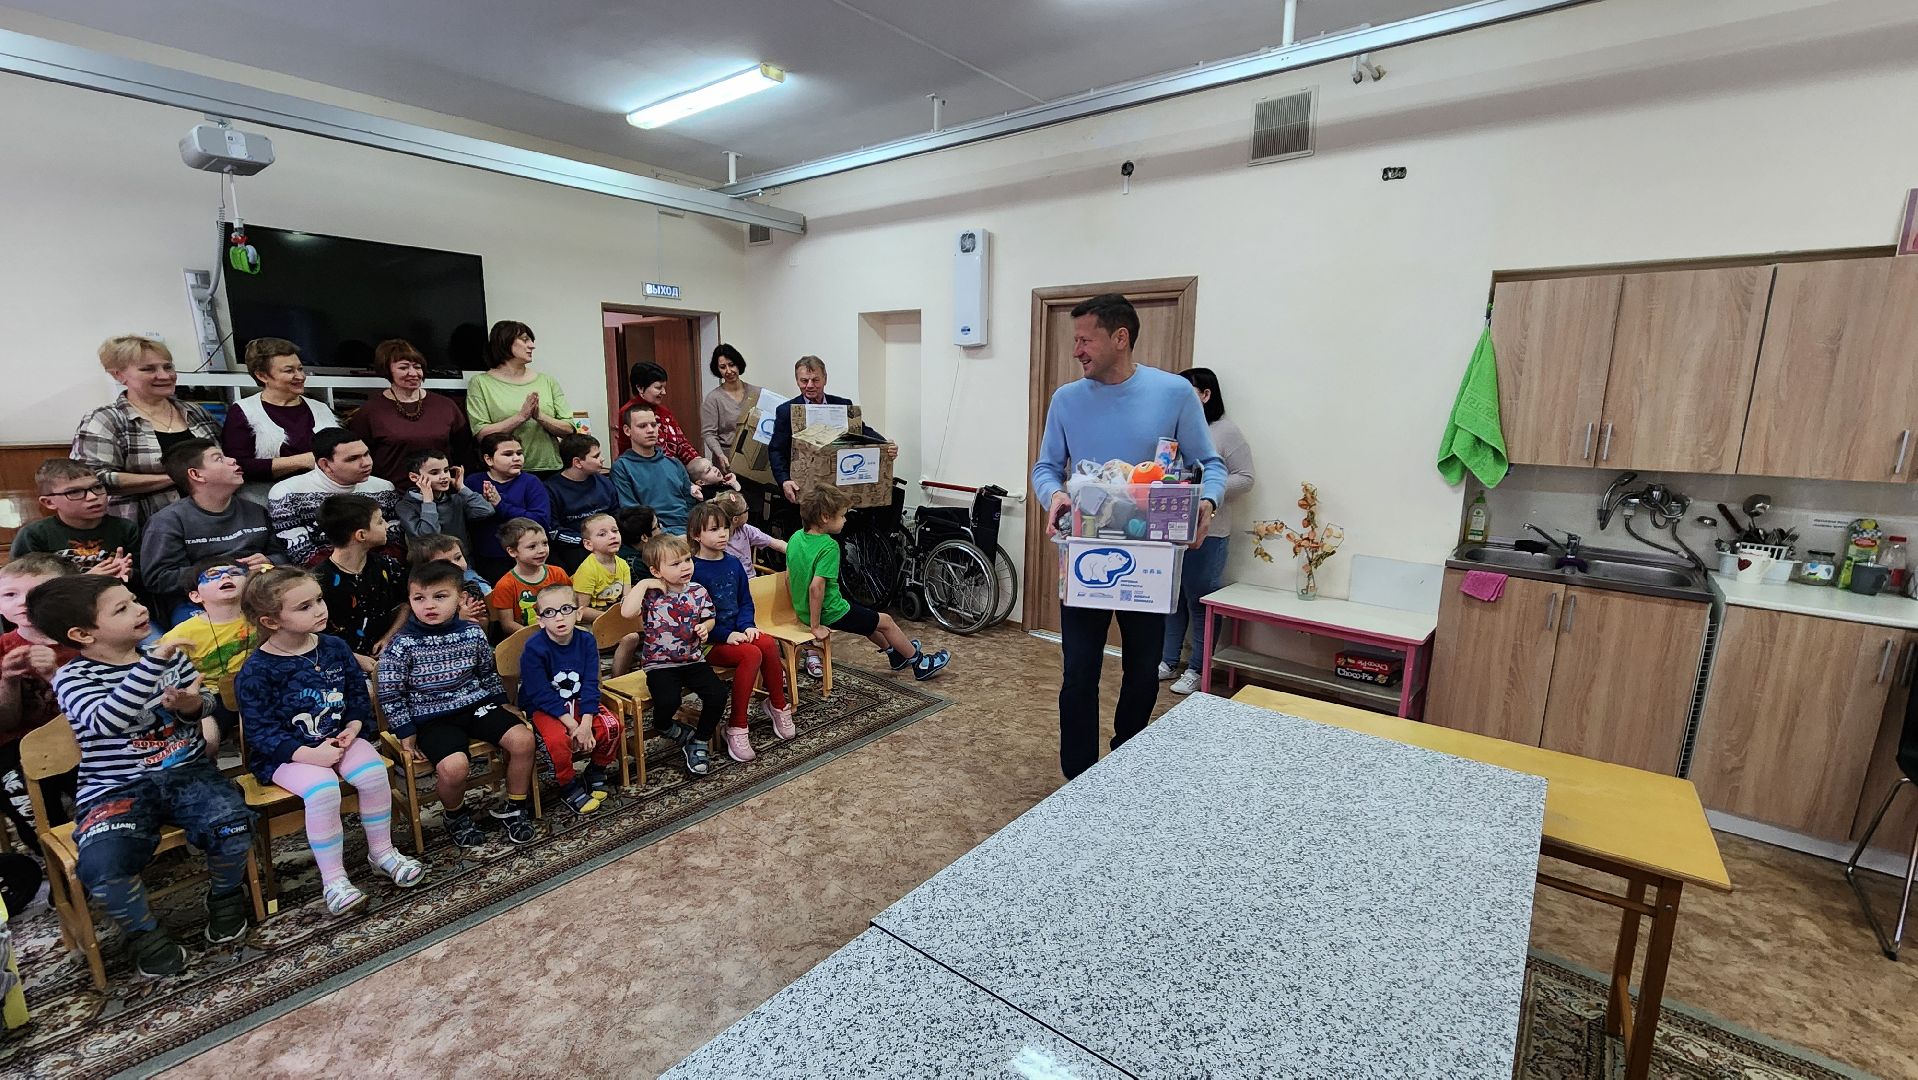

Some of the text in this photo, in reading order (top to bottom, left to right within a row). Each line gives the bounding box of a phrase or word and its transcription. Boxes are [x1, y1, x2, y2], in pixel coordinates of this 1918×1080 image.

[646, 284, 679, 297] ВЫХОД
[1337, 667, 1373, 680] Choco-Pie
[111, 822, 136, 831] LIANG
